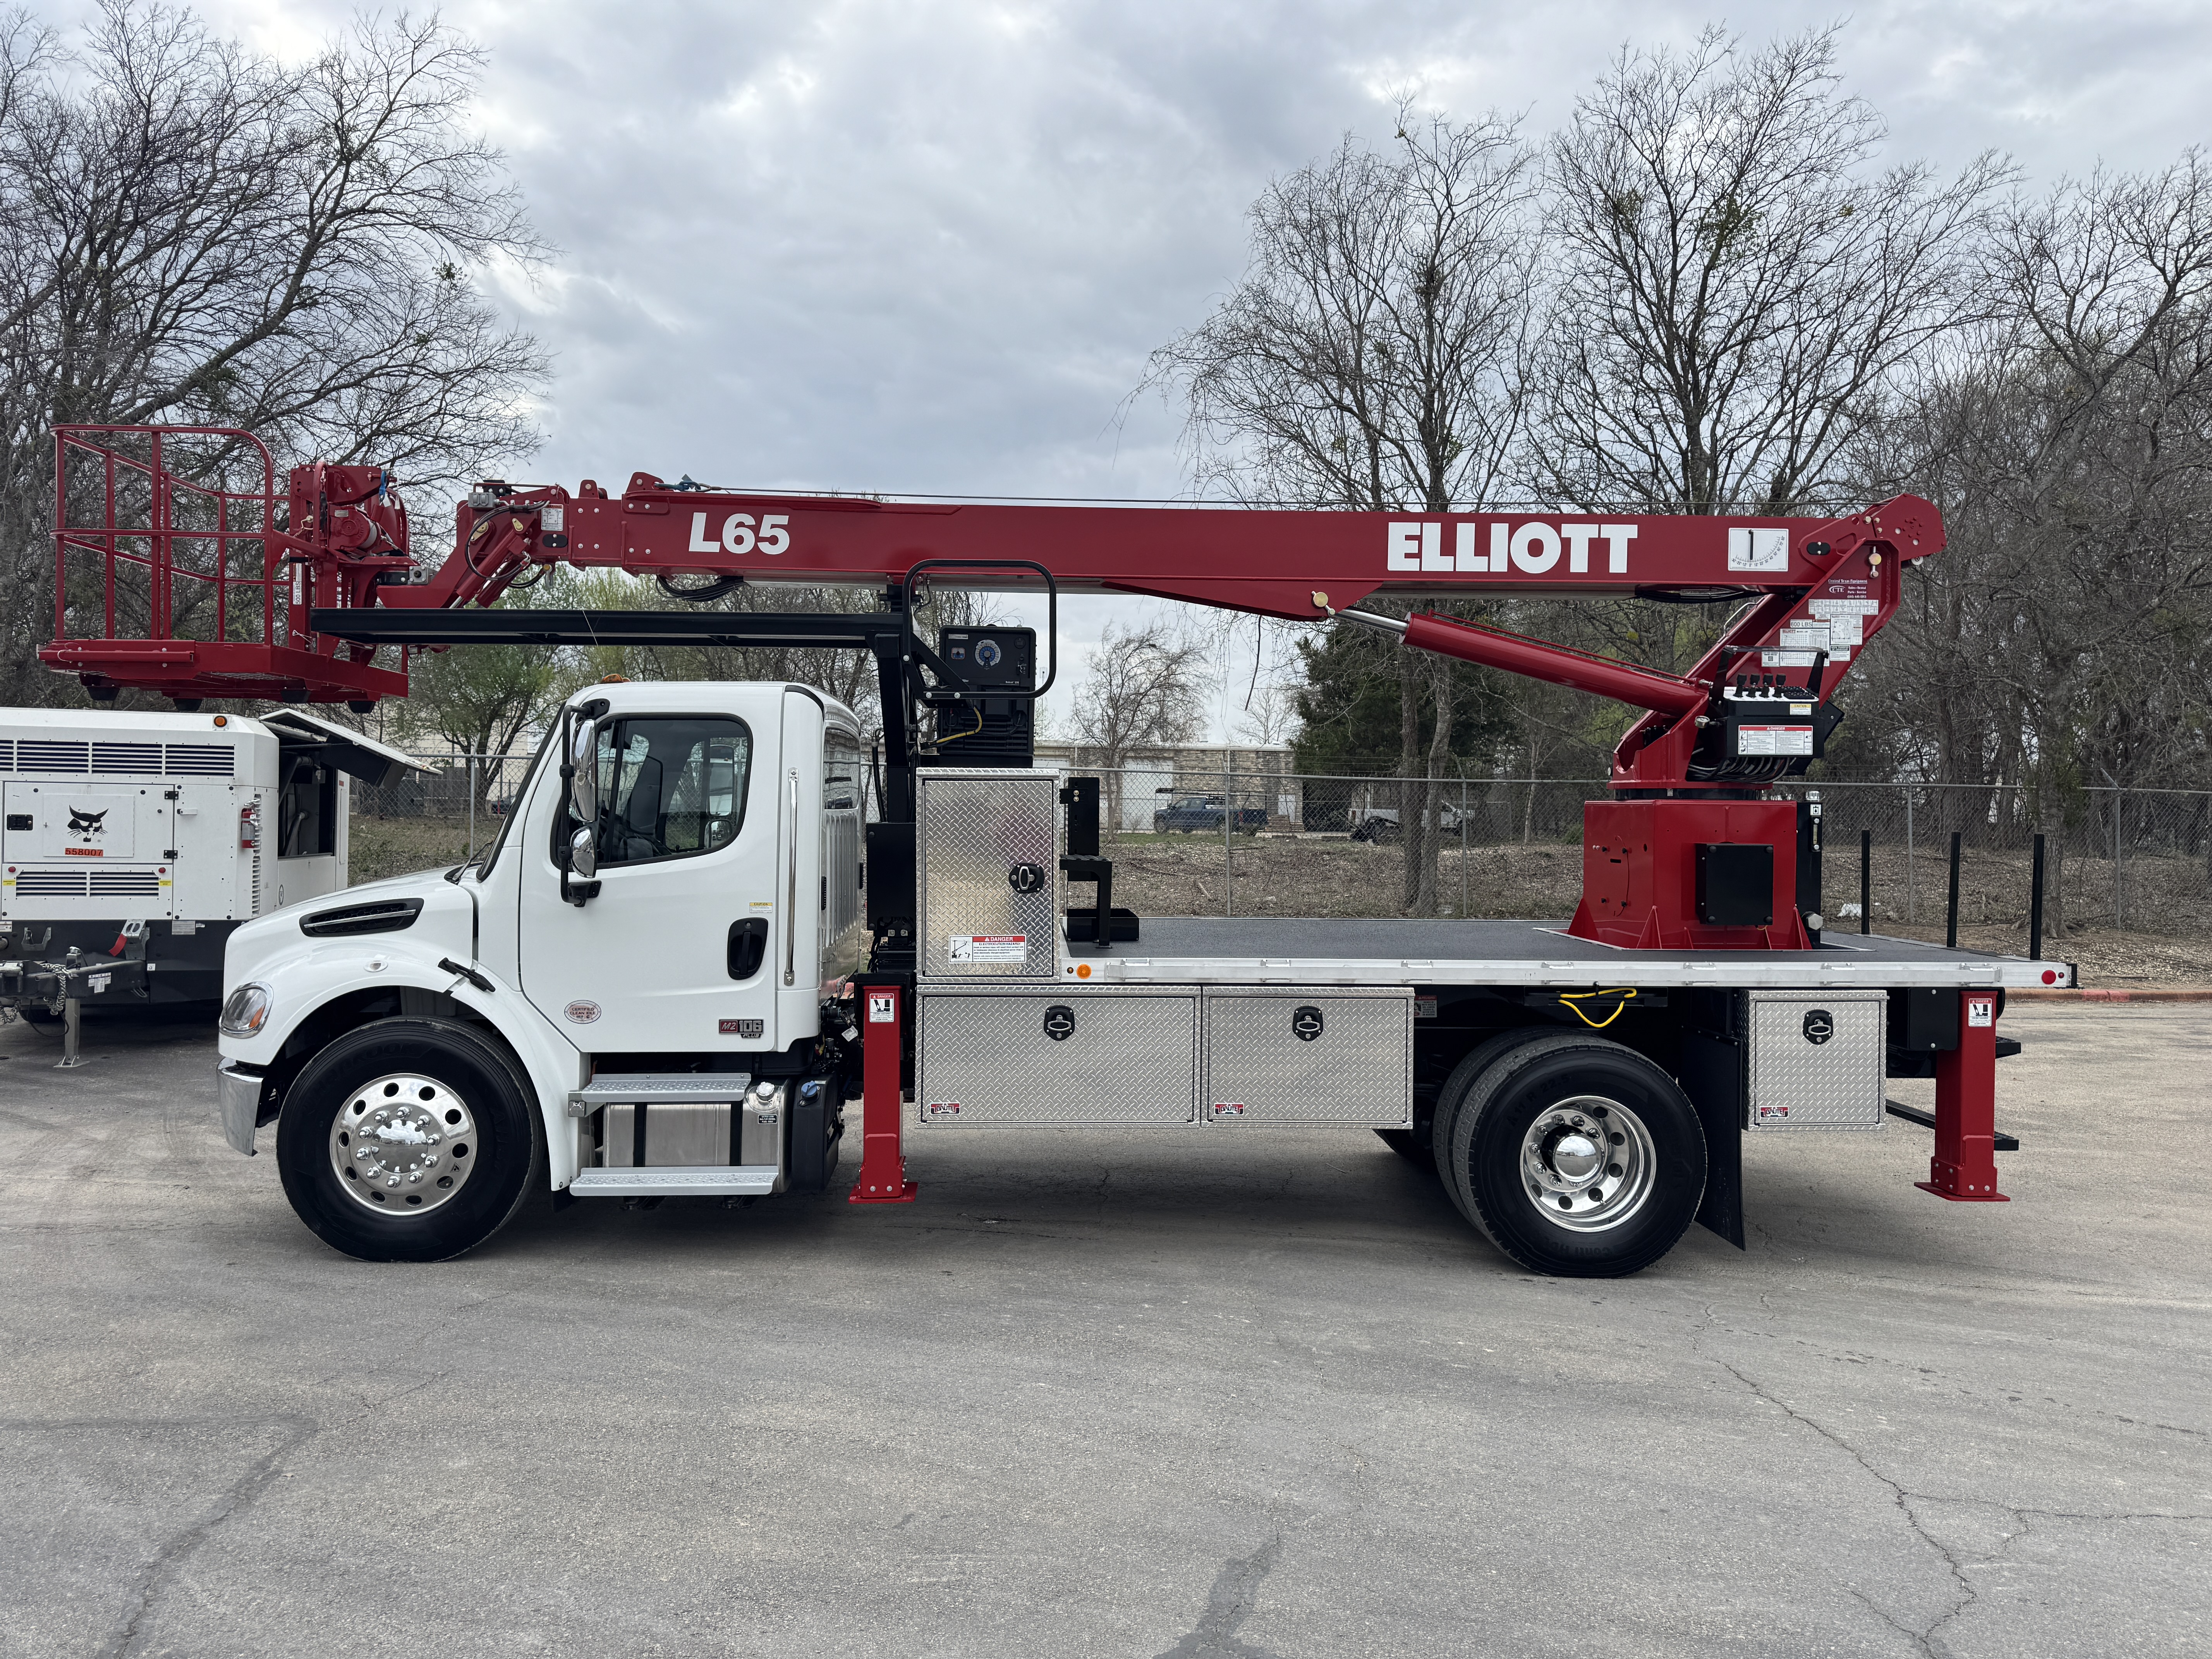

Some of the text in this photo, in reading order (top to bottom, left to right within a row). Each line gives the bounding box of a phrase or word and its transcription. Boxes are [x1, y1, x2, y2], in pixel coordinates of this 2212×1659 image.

[689, 512, 790, 555] L65
[1387, 522, 1638, 574] ELLIOTT
[65, 848, 103, 856] 558007
[739, 1020, 762, 1032] 106
